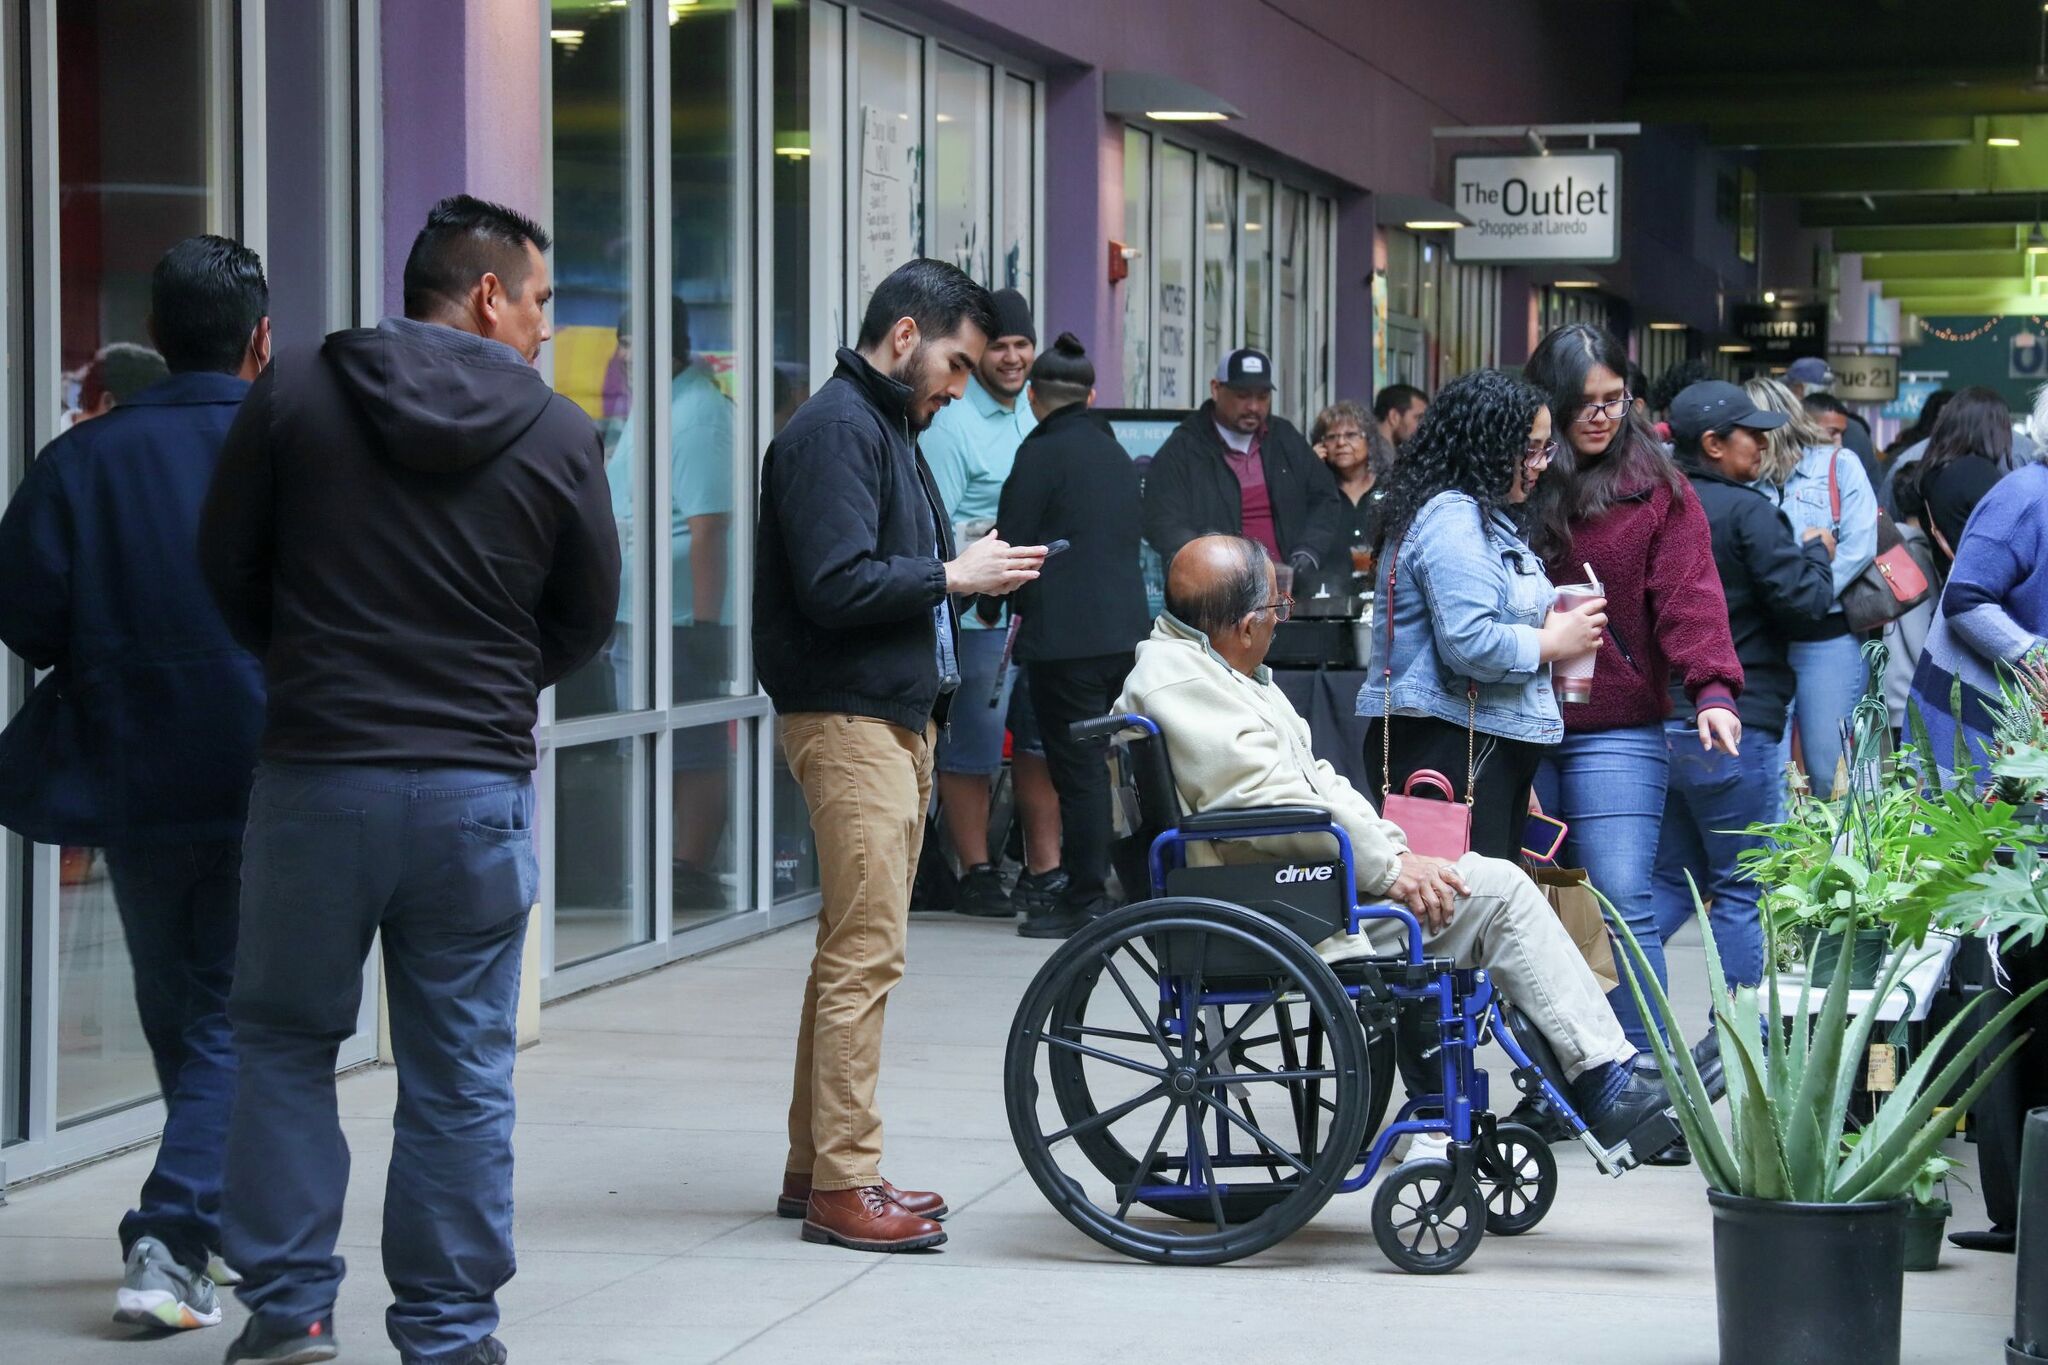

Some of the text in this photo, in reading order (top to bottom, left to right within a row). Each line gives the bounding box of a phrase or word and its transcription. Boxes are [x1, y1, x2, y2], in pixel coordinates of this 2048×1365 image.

[1461, 176, 1608, 216] The Outlet
[1478, 219, 1587, 238] Shoppes at Laredo
[1743, 321, 1815, 337] FOREVER 21
[1275, 864, 1333, 884] drive
